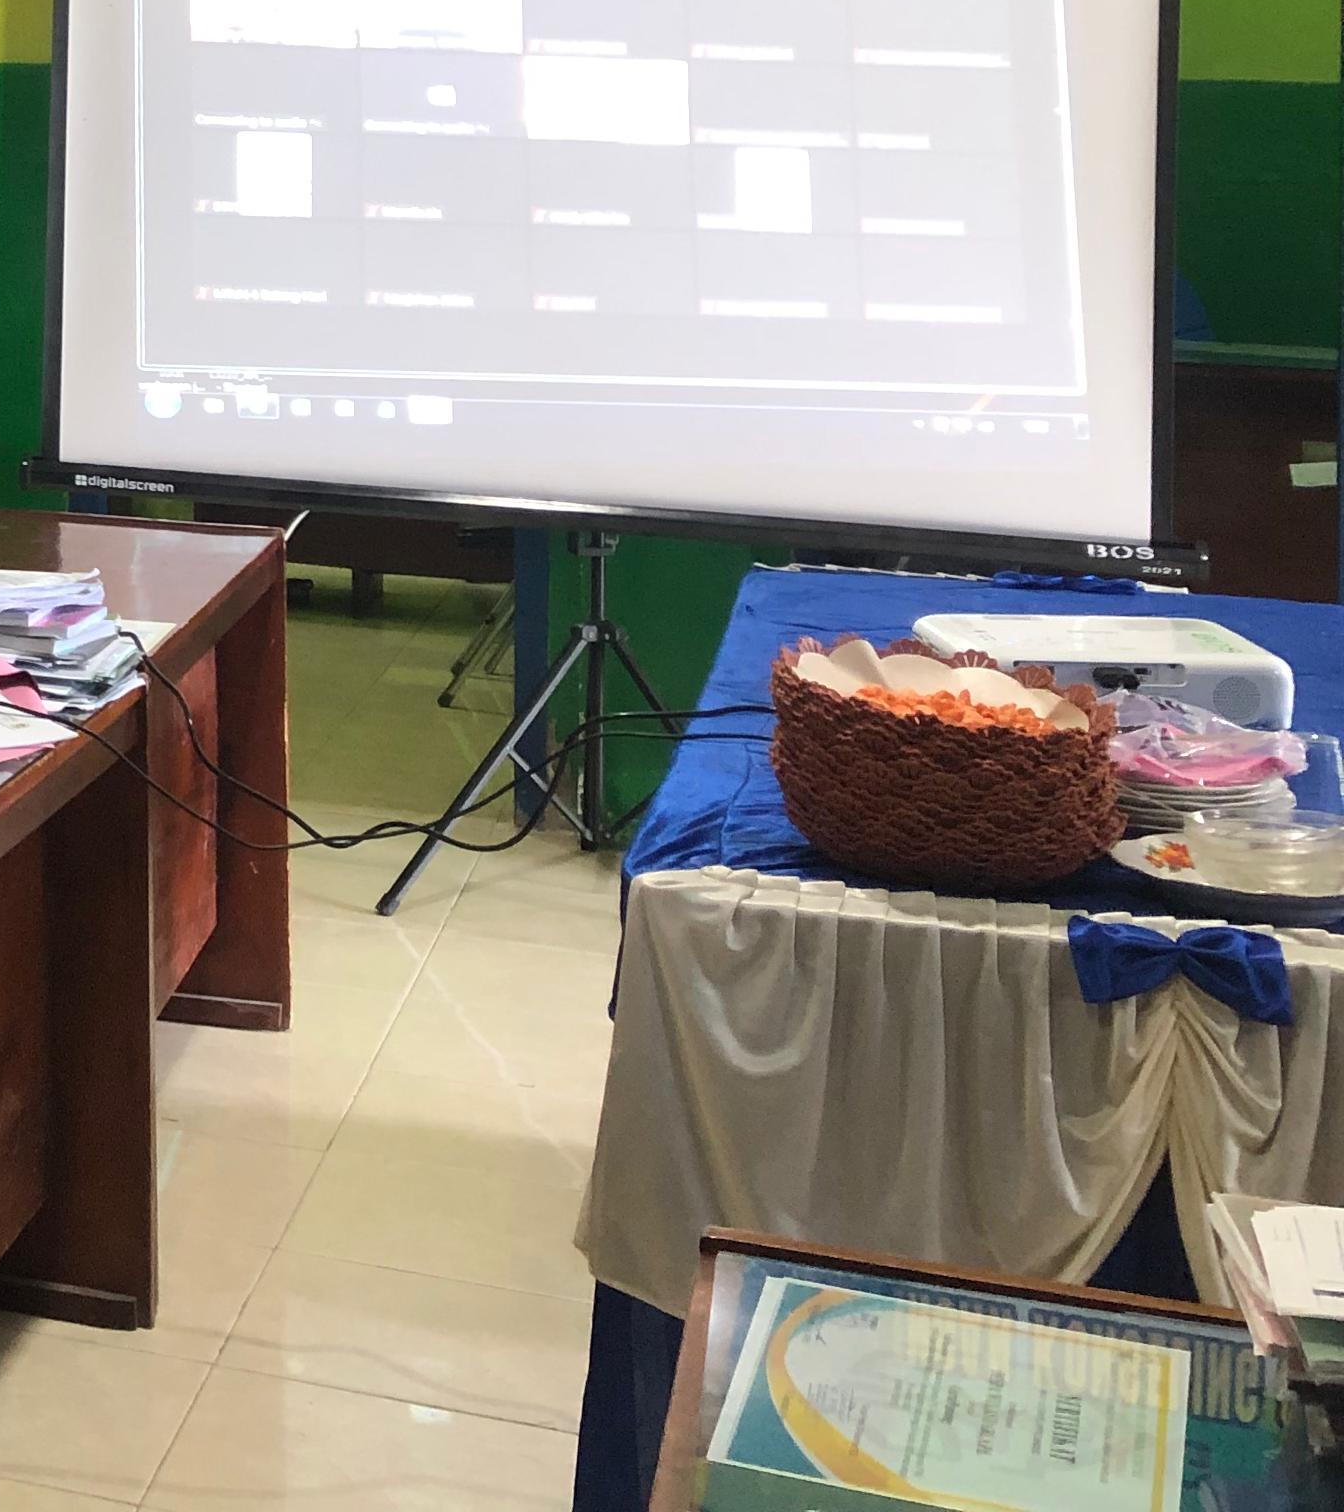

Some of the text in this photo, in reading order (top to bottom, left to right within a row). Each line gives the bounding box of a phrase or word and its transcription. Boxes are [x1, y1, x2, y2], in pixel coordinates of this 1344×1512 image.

[87, 475, 175, 494] digitalscreen
[1086, 543, 1155, 560] BOS
[1141, 565, 1182, 576] 2021
